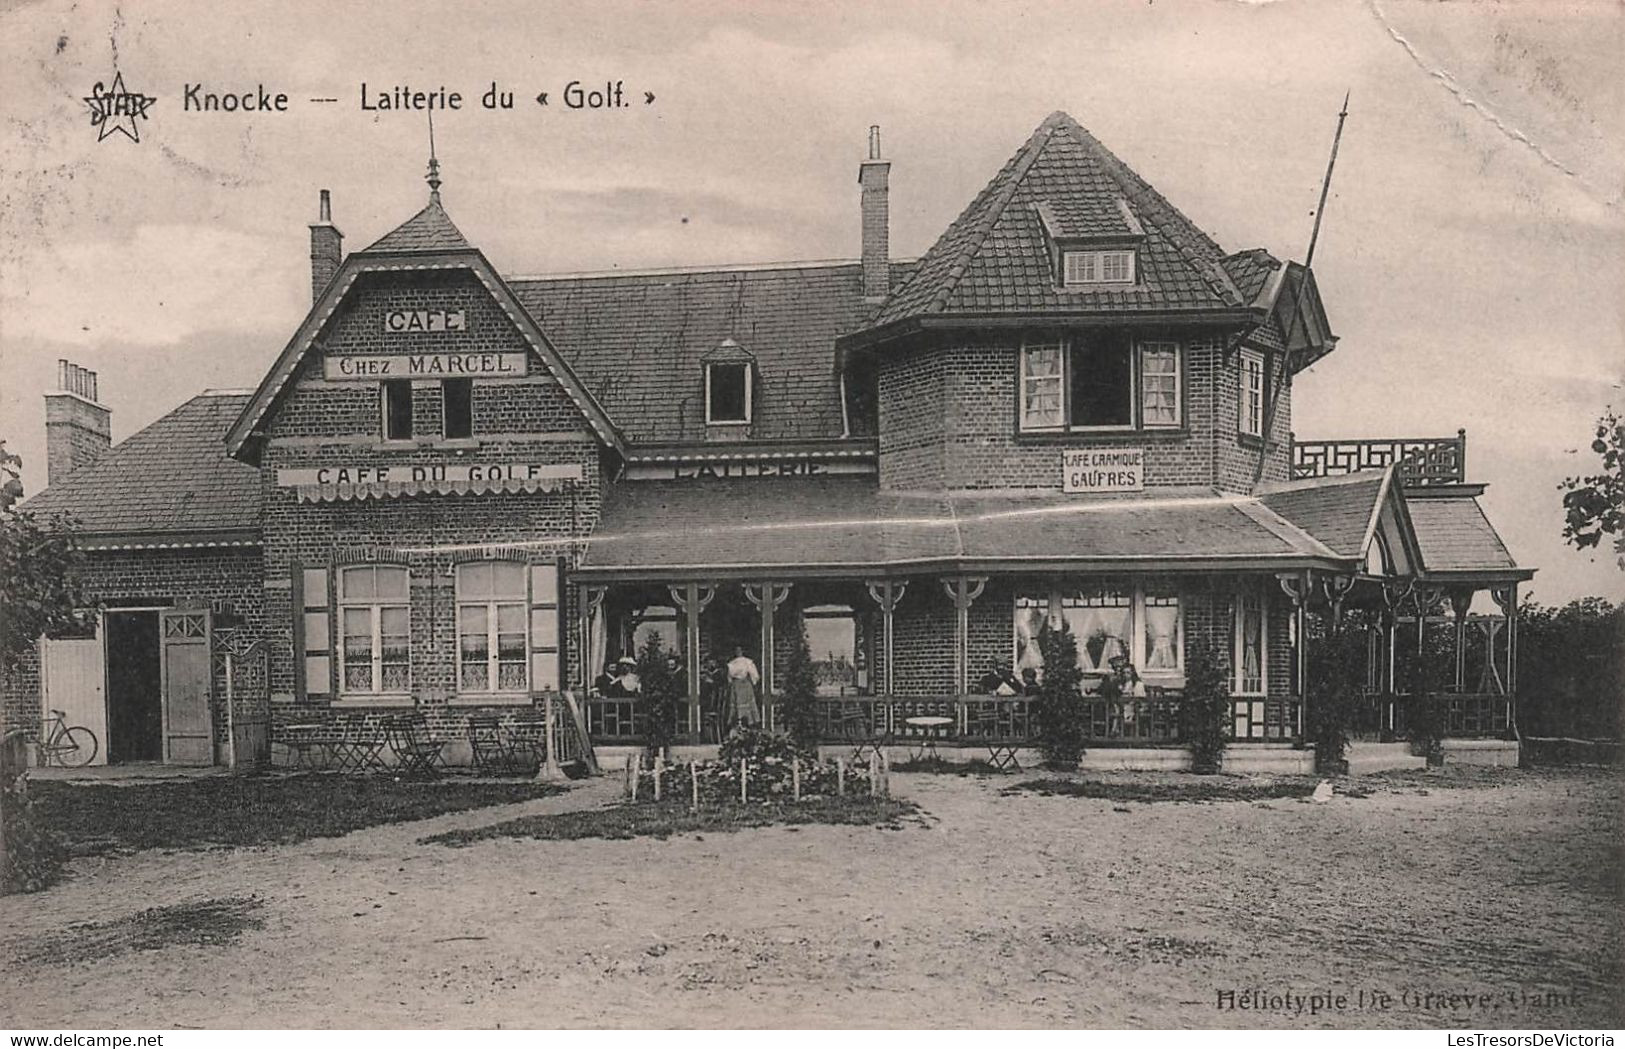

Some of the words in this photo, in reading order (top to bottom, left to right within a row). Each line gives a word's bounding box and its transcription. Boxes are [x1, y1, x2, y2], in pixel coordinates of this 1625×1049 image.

[388, 311, 460, 330] CAFE
[317, 467, 390, 485] CAFE
[412, 465, 446, 482] DU
[469, 464, 542, 482] GOLF
